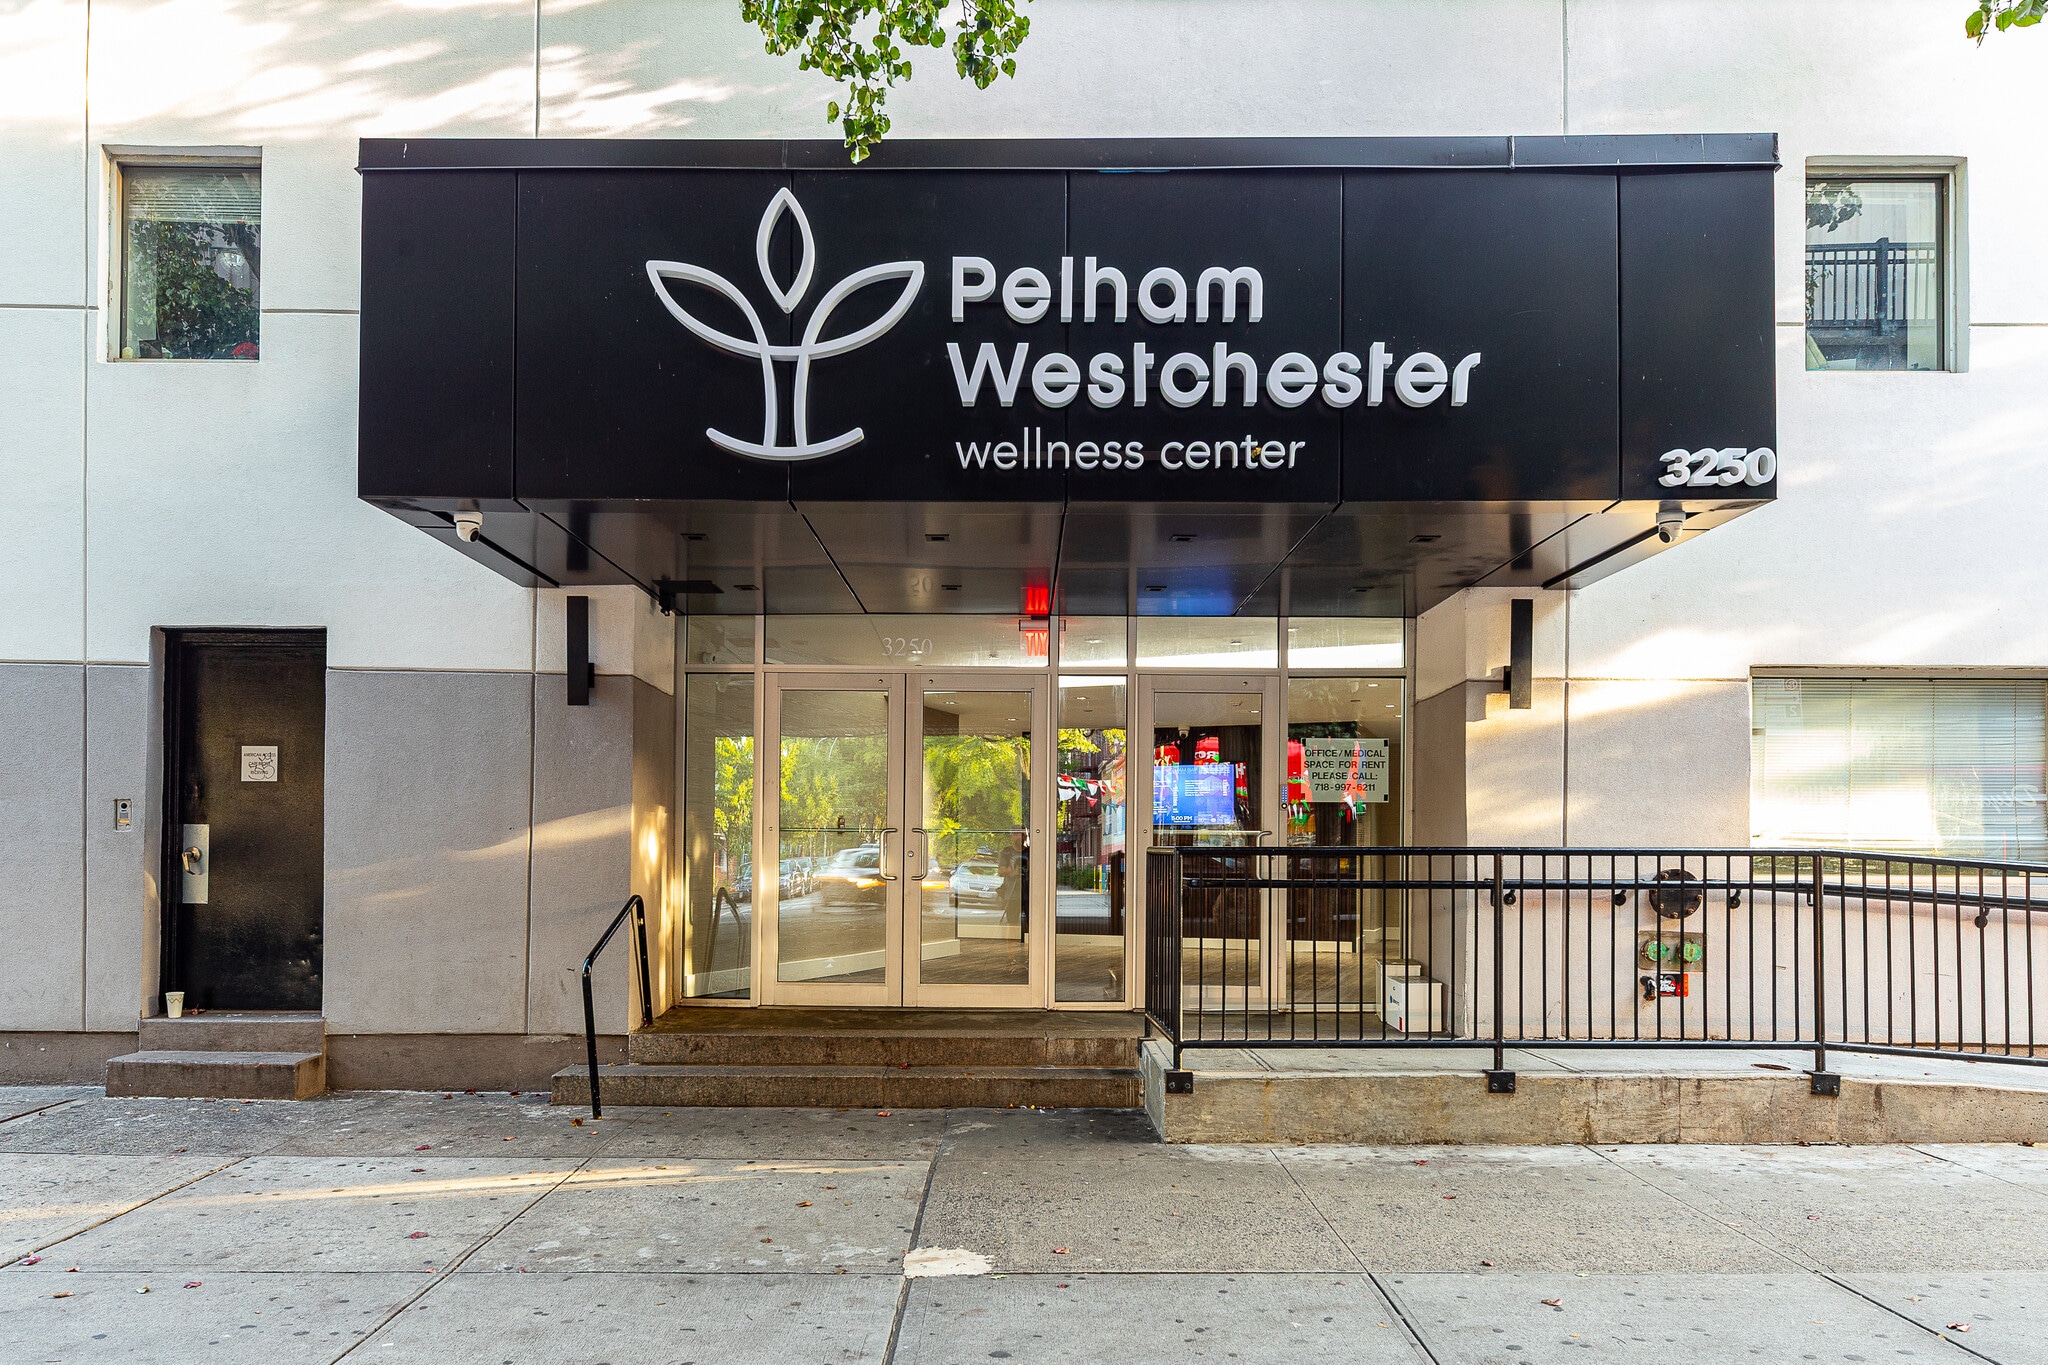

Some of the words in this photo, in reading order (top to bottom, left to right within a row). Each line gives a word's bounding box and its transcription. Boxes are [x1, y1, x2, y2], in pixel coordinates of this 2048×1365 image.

[951, 256, 1264, 324] Pelham
[946, 341, 1482, 409] Westchester
[955, 426, 1145, 470] wellness
[1160, 434, 1306, 470] center
[1658, 447, 1777, 488] 3250
[882, 637, 934, 657] 3250
[1303, 760, 1335, 769] SPACE
[1338, 760, 1358, 769] FOR
[1361, 760, 1386, 769] RENT
[1311, 771, 1348, 780] PLEASE
[1351, 771, 1378, 780] CALL:
[1314, 783, 1376, 792] 718-997-6211
